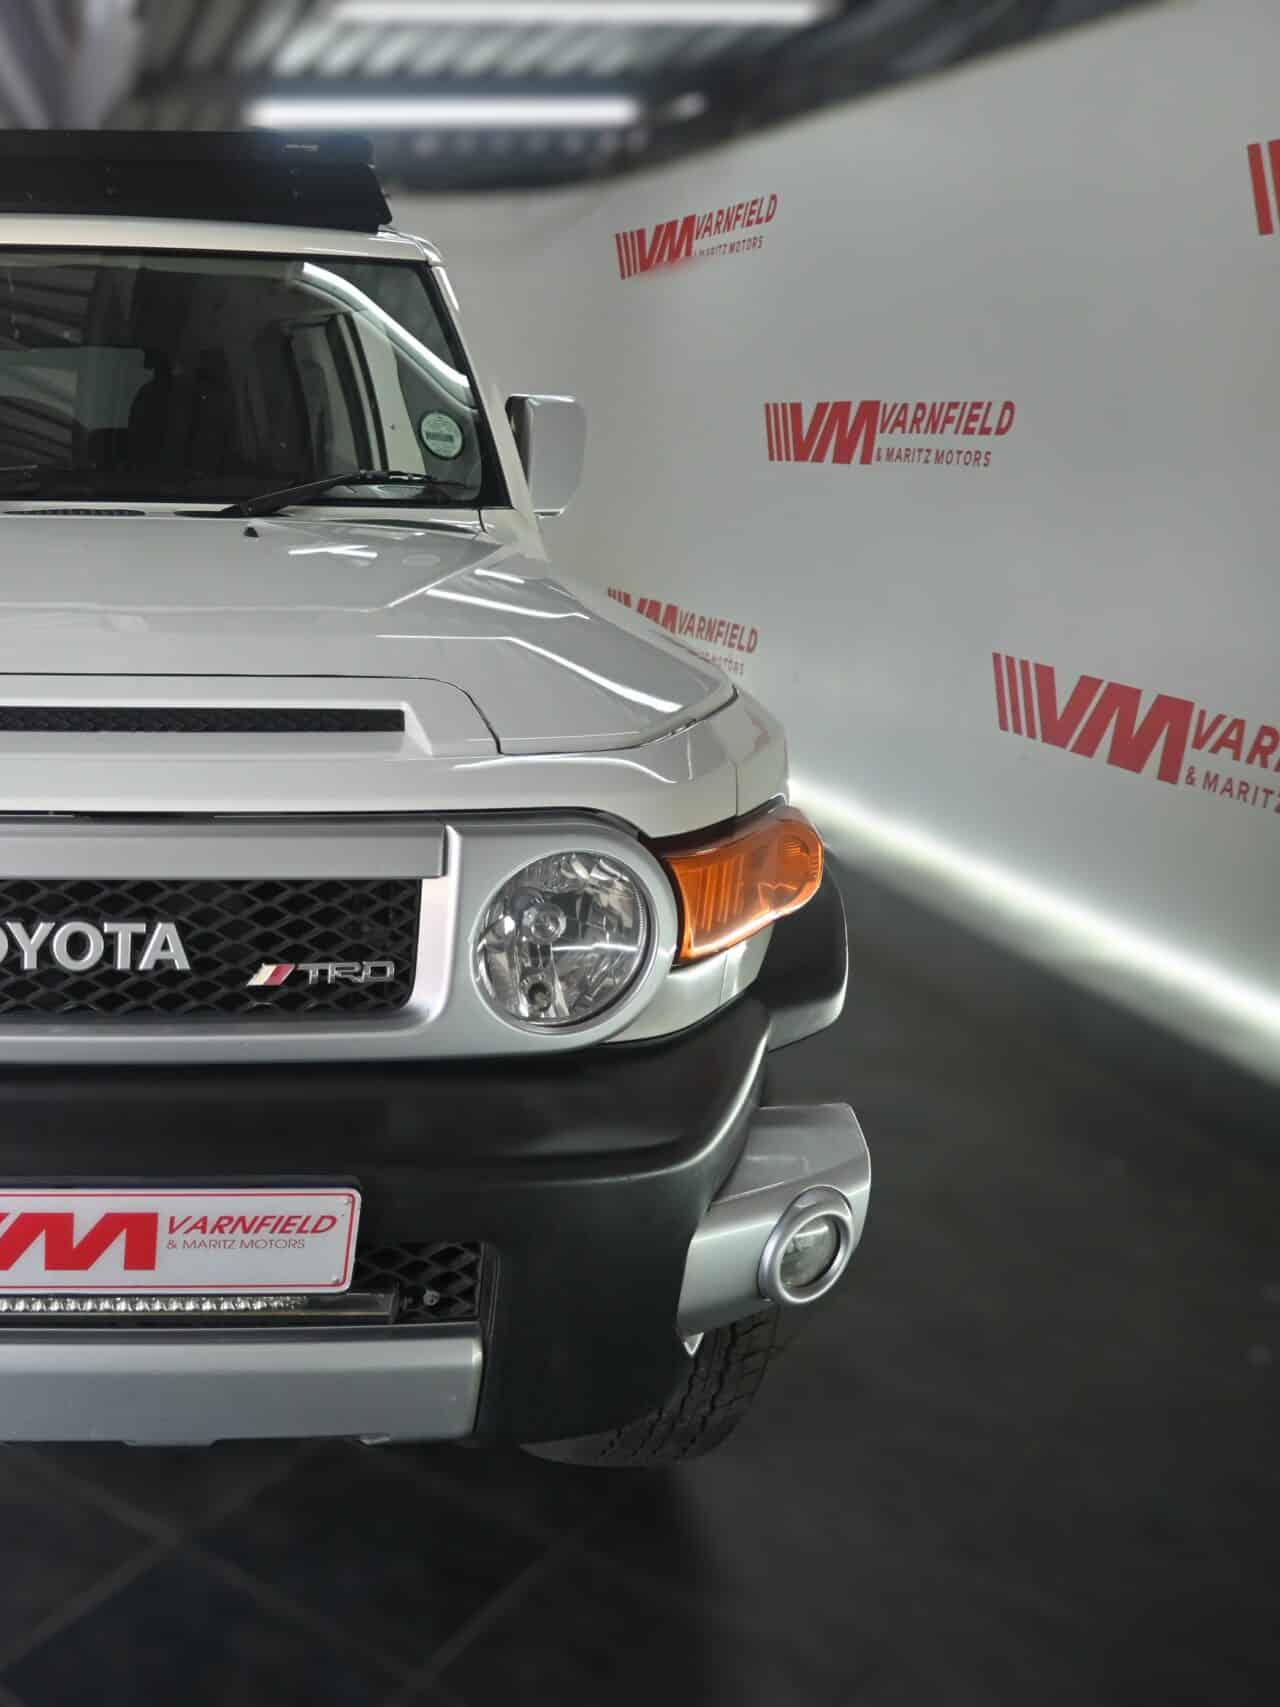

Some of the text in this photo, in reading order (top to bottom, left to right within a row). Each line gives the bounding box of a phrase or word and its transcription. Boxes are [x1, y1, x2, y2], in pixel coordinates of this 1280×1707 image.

[695, 193, 778, 240] VARNFIELD
[728, 236, 763, 254] MOTORS
[879, 401, 1015, 435] VARNFIELD
[885, 448, 931, 463] MARITZ
[934, 449, 991, 467] MOTORS
[679, 609, 758, 653] VARNFIELD
[1191, 709, 1280, 773] VAR
[1185, 766, 1196, 786] &
[297, 960, 395, 985] TRD
[168, 1215, 338, 1235] VARNFIELD
[168, 1239, 305, 1249] & MARITZ MOTORS
